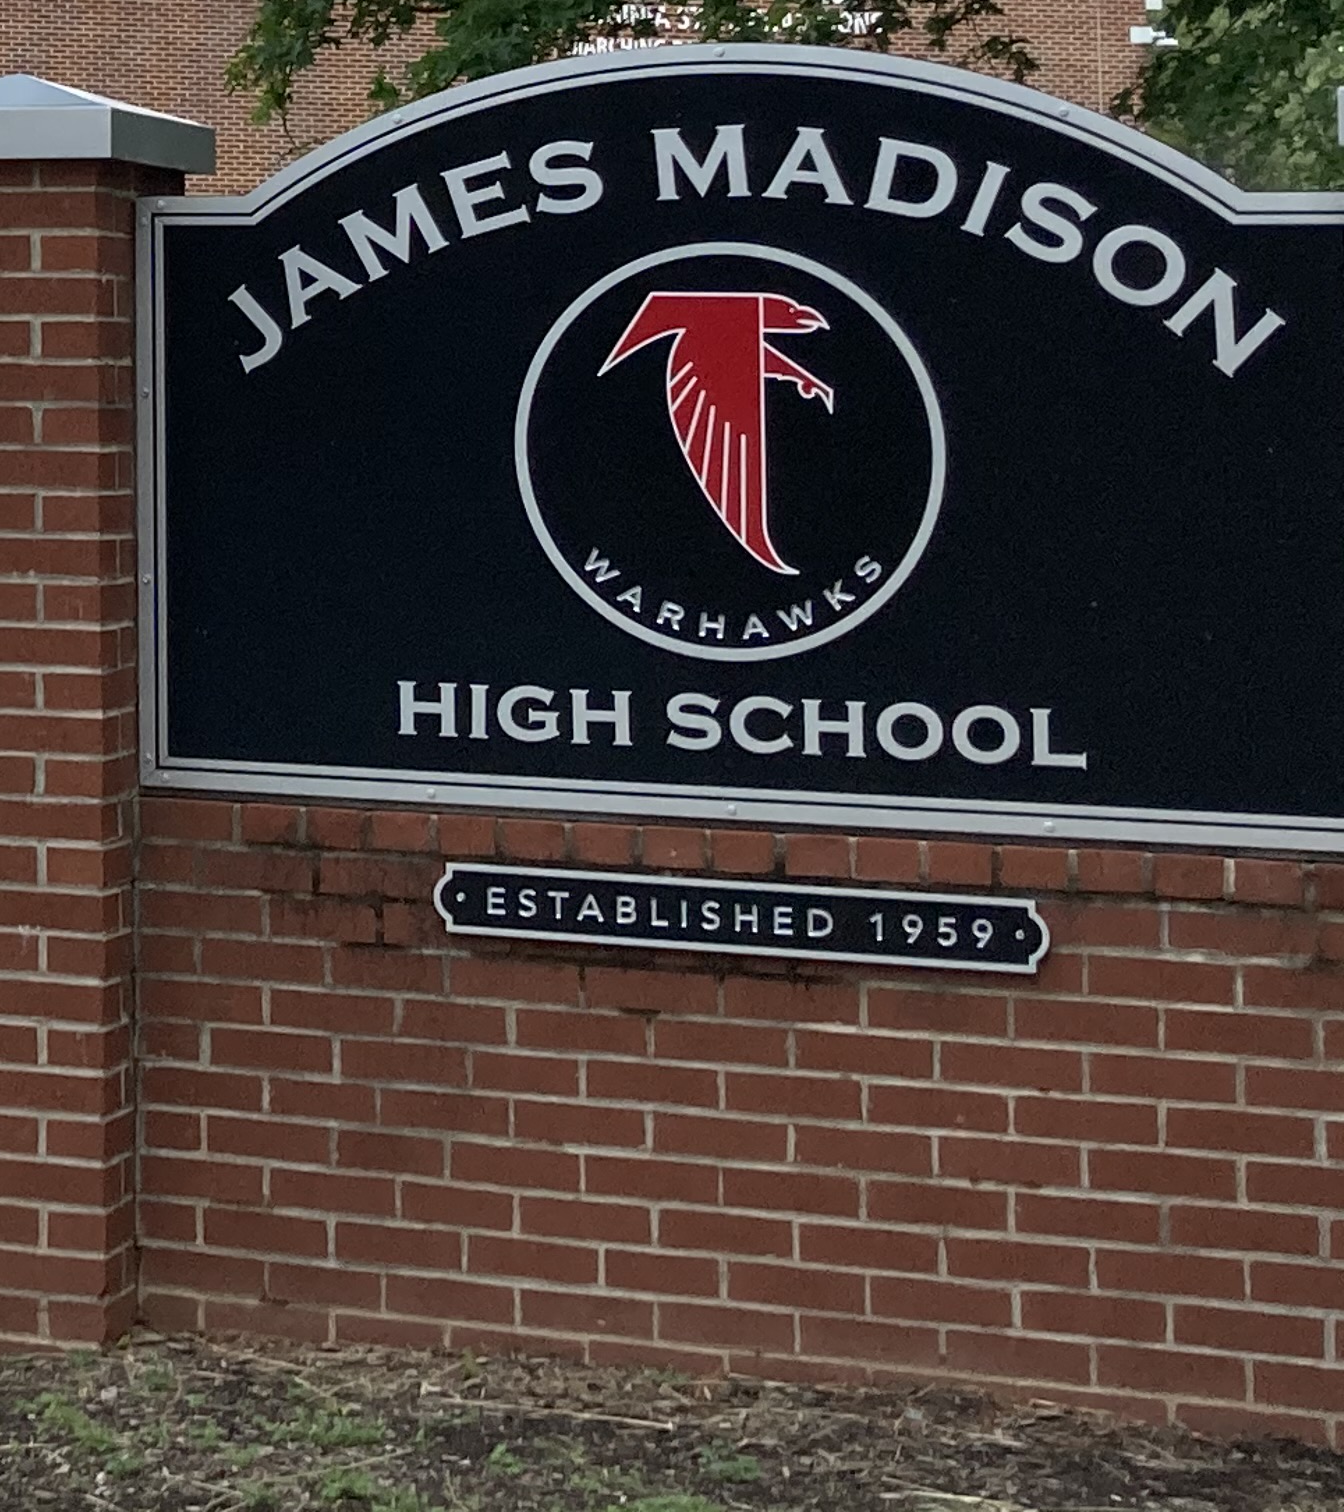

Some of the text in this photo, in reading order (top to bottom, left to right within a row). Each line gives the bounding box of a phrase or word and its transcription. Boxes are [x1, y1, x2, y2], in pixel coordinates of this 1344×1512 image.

[227, 124, 1286, 378] JAMES MADISON
[584, 546, 882, 640] WARHAWKS
[397, 681, 1087, 770] HIGH SCHOOL
[486, 887, 996, 949] ESTABLISHED 1959
